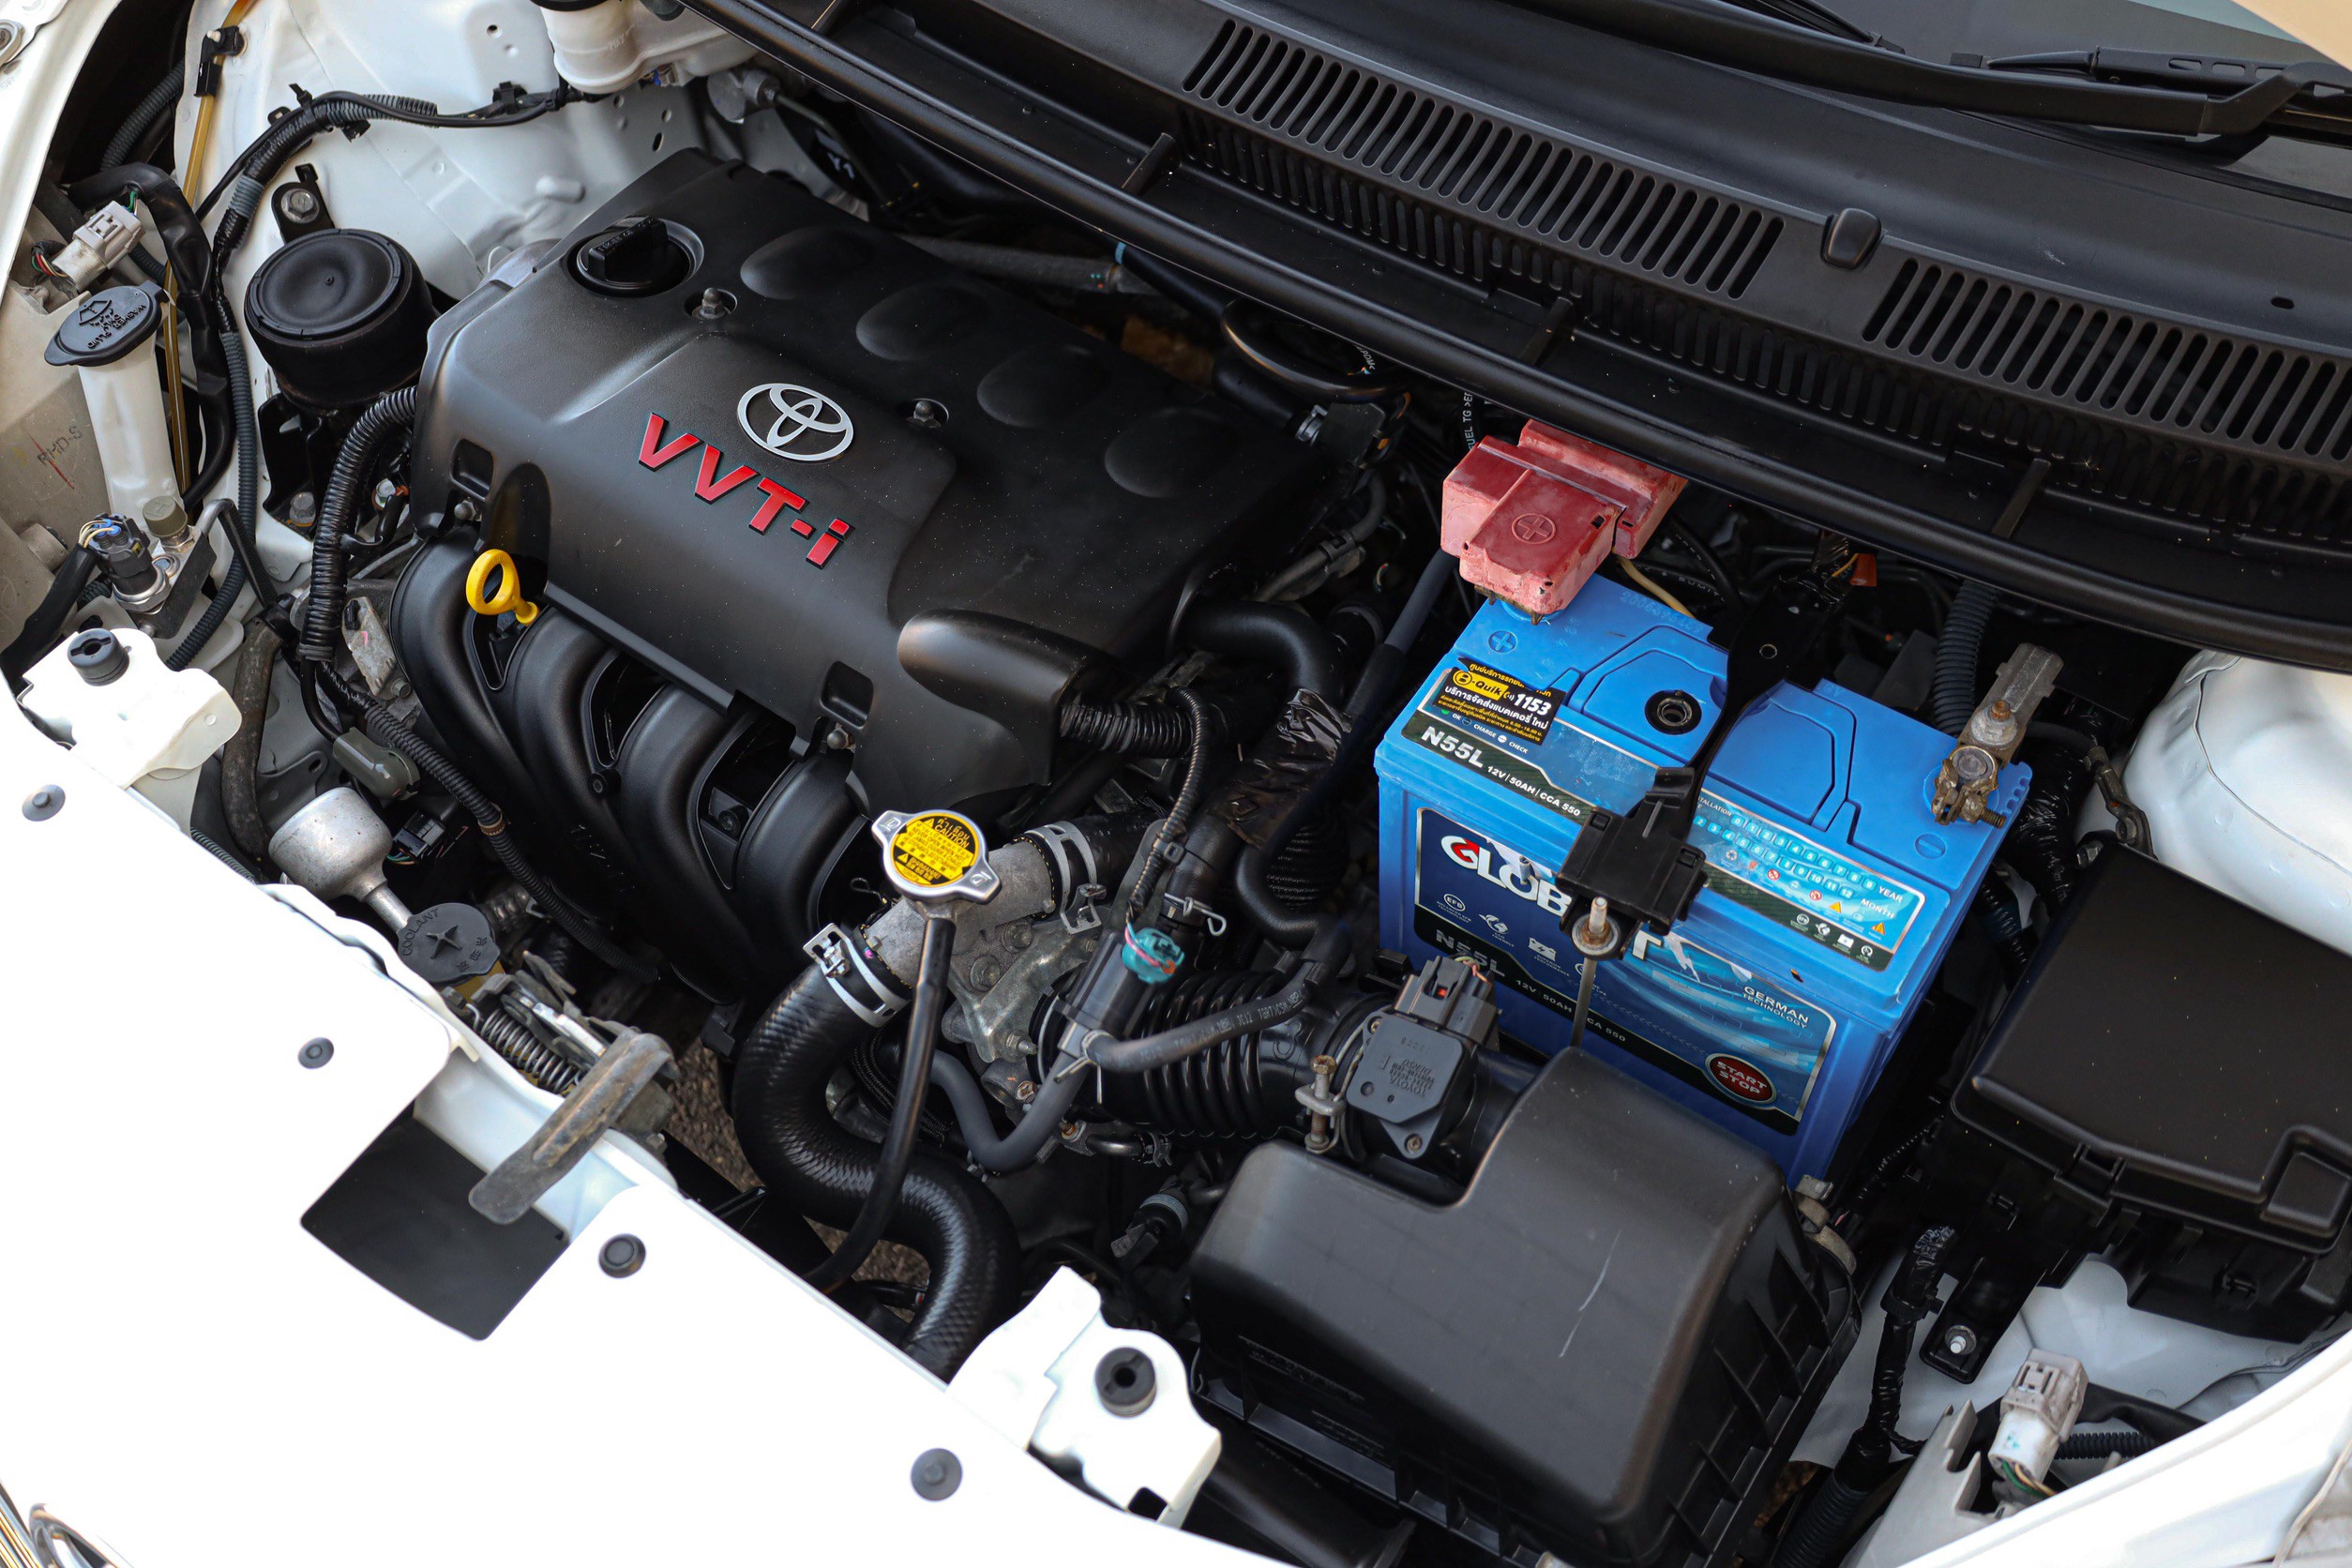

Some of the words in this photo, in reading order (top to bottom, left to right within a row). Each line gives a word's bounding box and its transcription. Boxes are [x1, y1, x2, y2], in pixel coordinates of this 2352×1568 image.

[1463, 410, 1471, 423] TG
[639, 413, 854, 570] VVT-i
[1514, 693, 1552, 716] 1153
[1452, 713, 1461, 721] OK
[1473, 723, 1498, 738] CHARGE
[1508, 741, 1529, 754] CHECK
[1421, 726, 1484, 768] N55L
[1486, 765, 1506, 778] 12V
[1509, 776, 1536, 794] 50AH
[1539, 792, 1560, 807] CCA
[1561, 802, 1581, 817] 550
[934, 824, 969, 849] CAUTION
[1446, 896, 1463, 909] EFB
[1877, 886, 1904, 903] YEAR
[1861, 898, 1895, 919] MONTH
[402, 908, 439, 957] COOLANT
[1533, 956, 1571, 977] PERFORMANCE
[1515, 979, 1536, 993] 12V
[1606, 1028, 1626, 1042] 550
[1742, 992, 1808, 1030] TECHNOLOGY
[1743, 986, 1809, 1024] GERMAN
[1401, 1059, 1433, 1075] DENSO
[1716, 1060, 1768, 1090] START
[1389, 1074, 1425, 1097] TOYOTA
[1719, 1070, 1761, 1094] STOP
